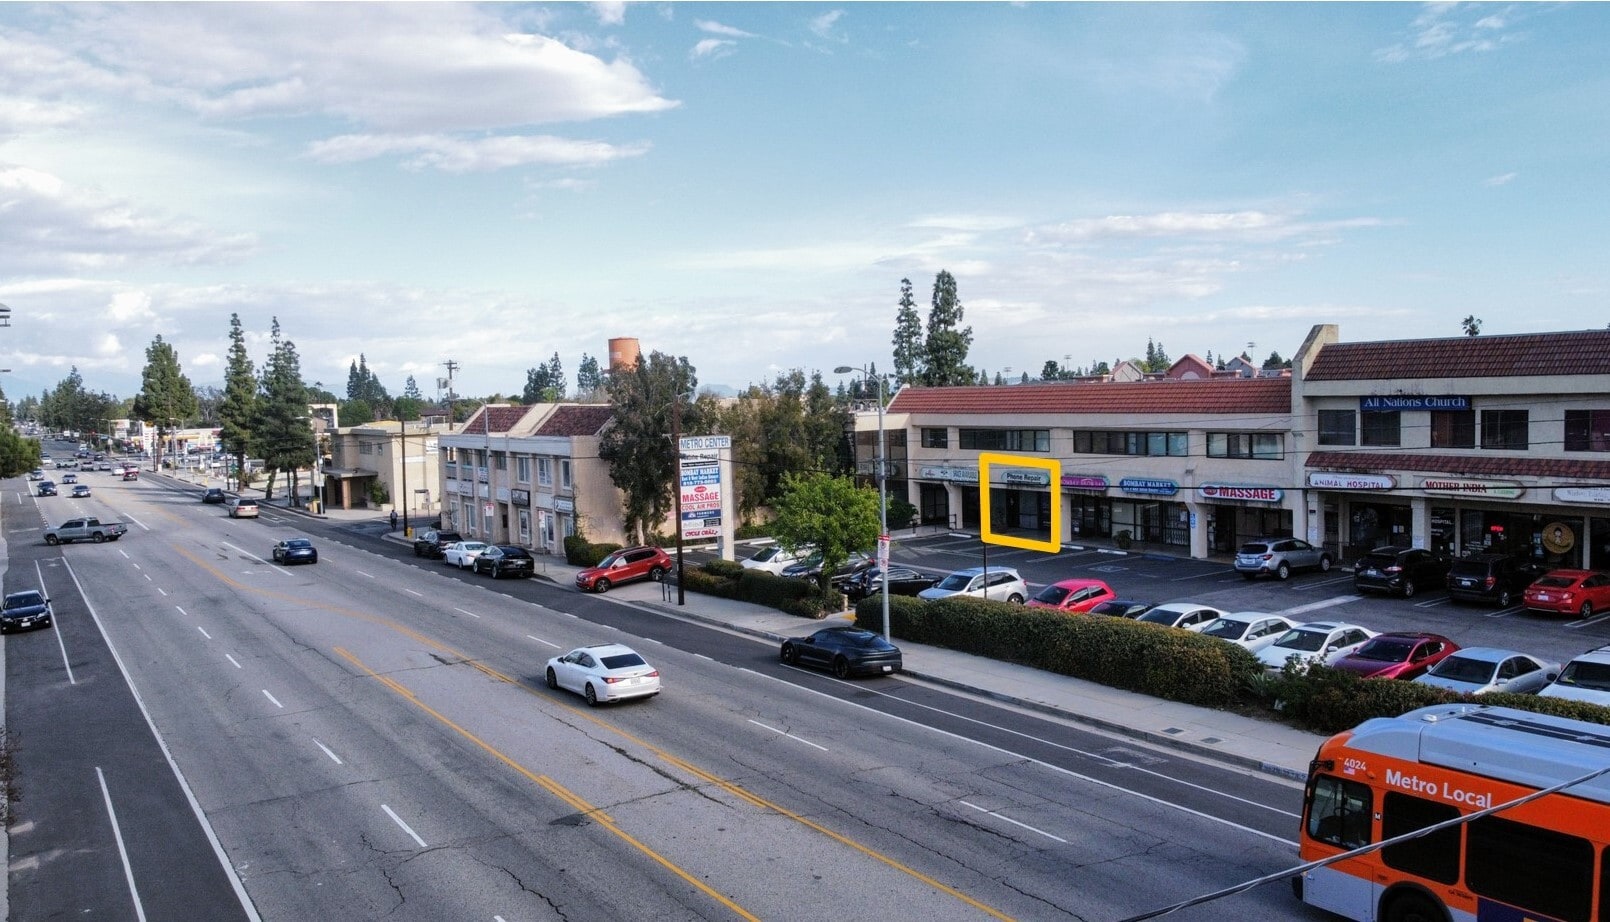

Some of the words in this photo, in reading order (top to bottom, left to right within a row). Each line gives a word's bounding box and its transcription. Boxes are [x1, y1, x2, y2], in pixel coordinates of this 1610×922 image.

[1365, 398, 1379, 407] All
[1383, 398, 1421, 407] Nations
[1425, 397, 1466, 407] Church
[681, 439, 703, 449] METRO
[705, 437, 729, 447] CENTER
[1006, 473, 1022, 481] Phone
[1024, 474, 1041, 482] Repair
[1346, 481, 1384, 489] HOSPITAL
[1426, 481, 1459, 491] MOTHER
[1463, 483, 1487, 493] INDIA
[682, 492, 719, 502] MASSAGE
[1219, 486, 1275, 499] MASSAGE
[1344, 758, 1367, 771] 4024
[1385, 769, 1438, 795] Metro
[1443, 782, 1492, 809] Local
